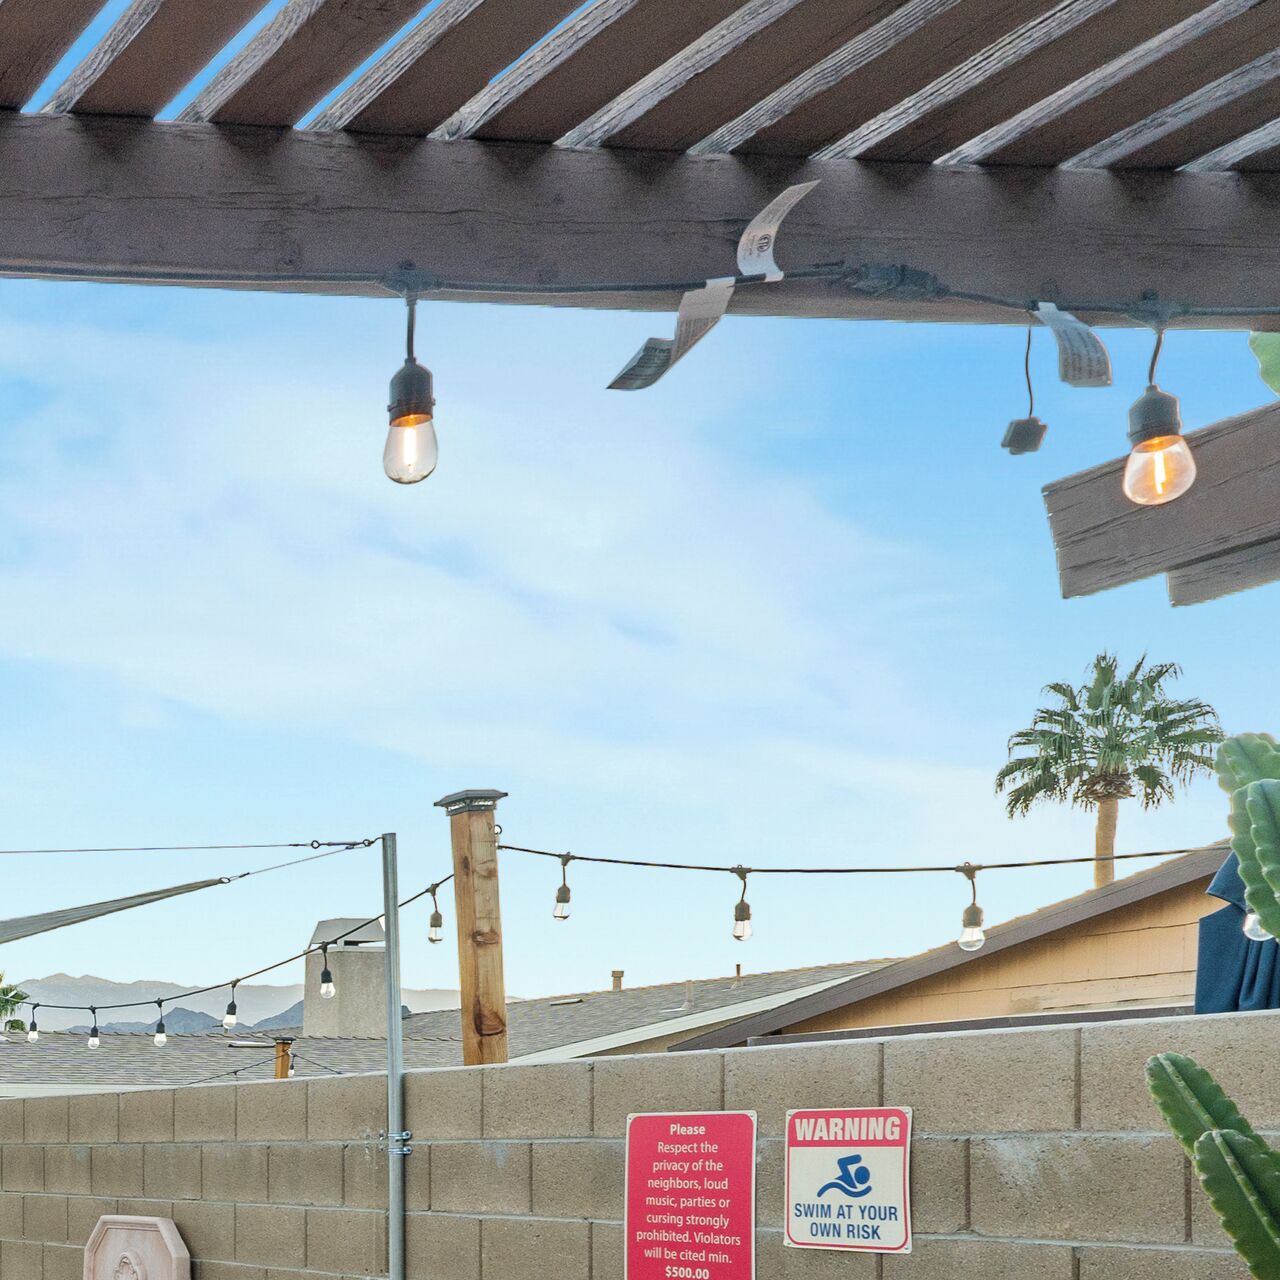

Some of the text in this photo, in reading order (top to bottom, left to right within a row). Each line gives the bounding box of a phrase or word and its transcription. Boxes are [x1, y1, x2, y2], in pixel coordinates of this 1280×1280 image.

[670, 1124, 706, 1135] Please
[795, 1116, 900, 1141] WARNING
[658, 1141, 718, 1155] Respect the
[652, 1159, 724, 1173] privacy of the
[647, 1177, 728, 1191] neighbors, loud
[646, 1196, 730, 1209] music, parties or
[794, 1203, 898, 1221] SWIM AT YOUR
[646, 1213, 729, 1229] cursing strongly
[636, 1230, 741, 1245] prohibited. Violators
[810, 1222, 881, 1240] OWN RISK
[644, 1247, 732, 1263] will be cited min.
[665, 1265, 709, 1280] $500.00
